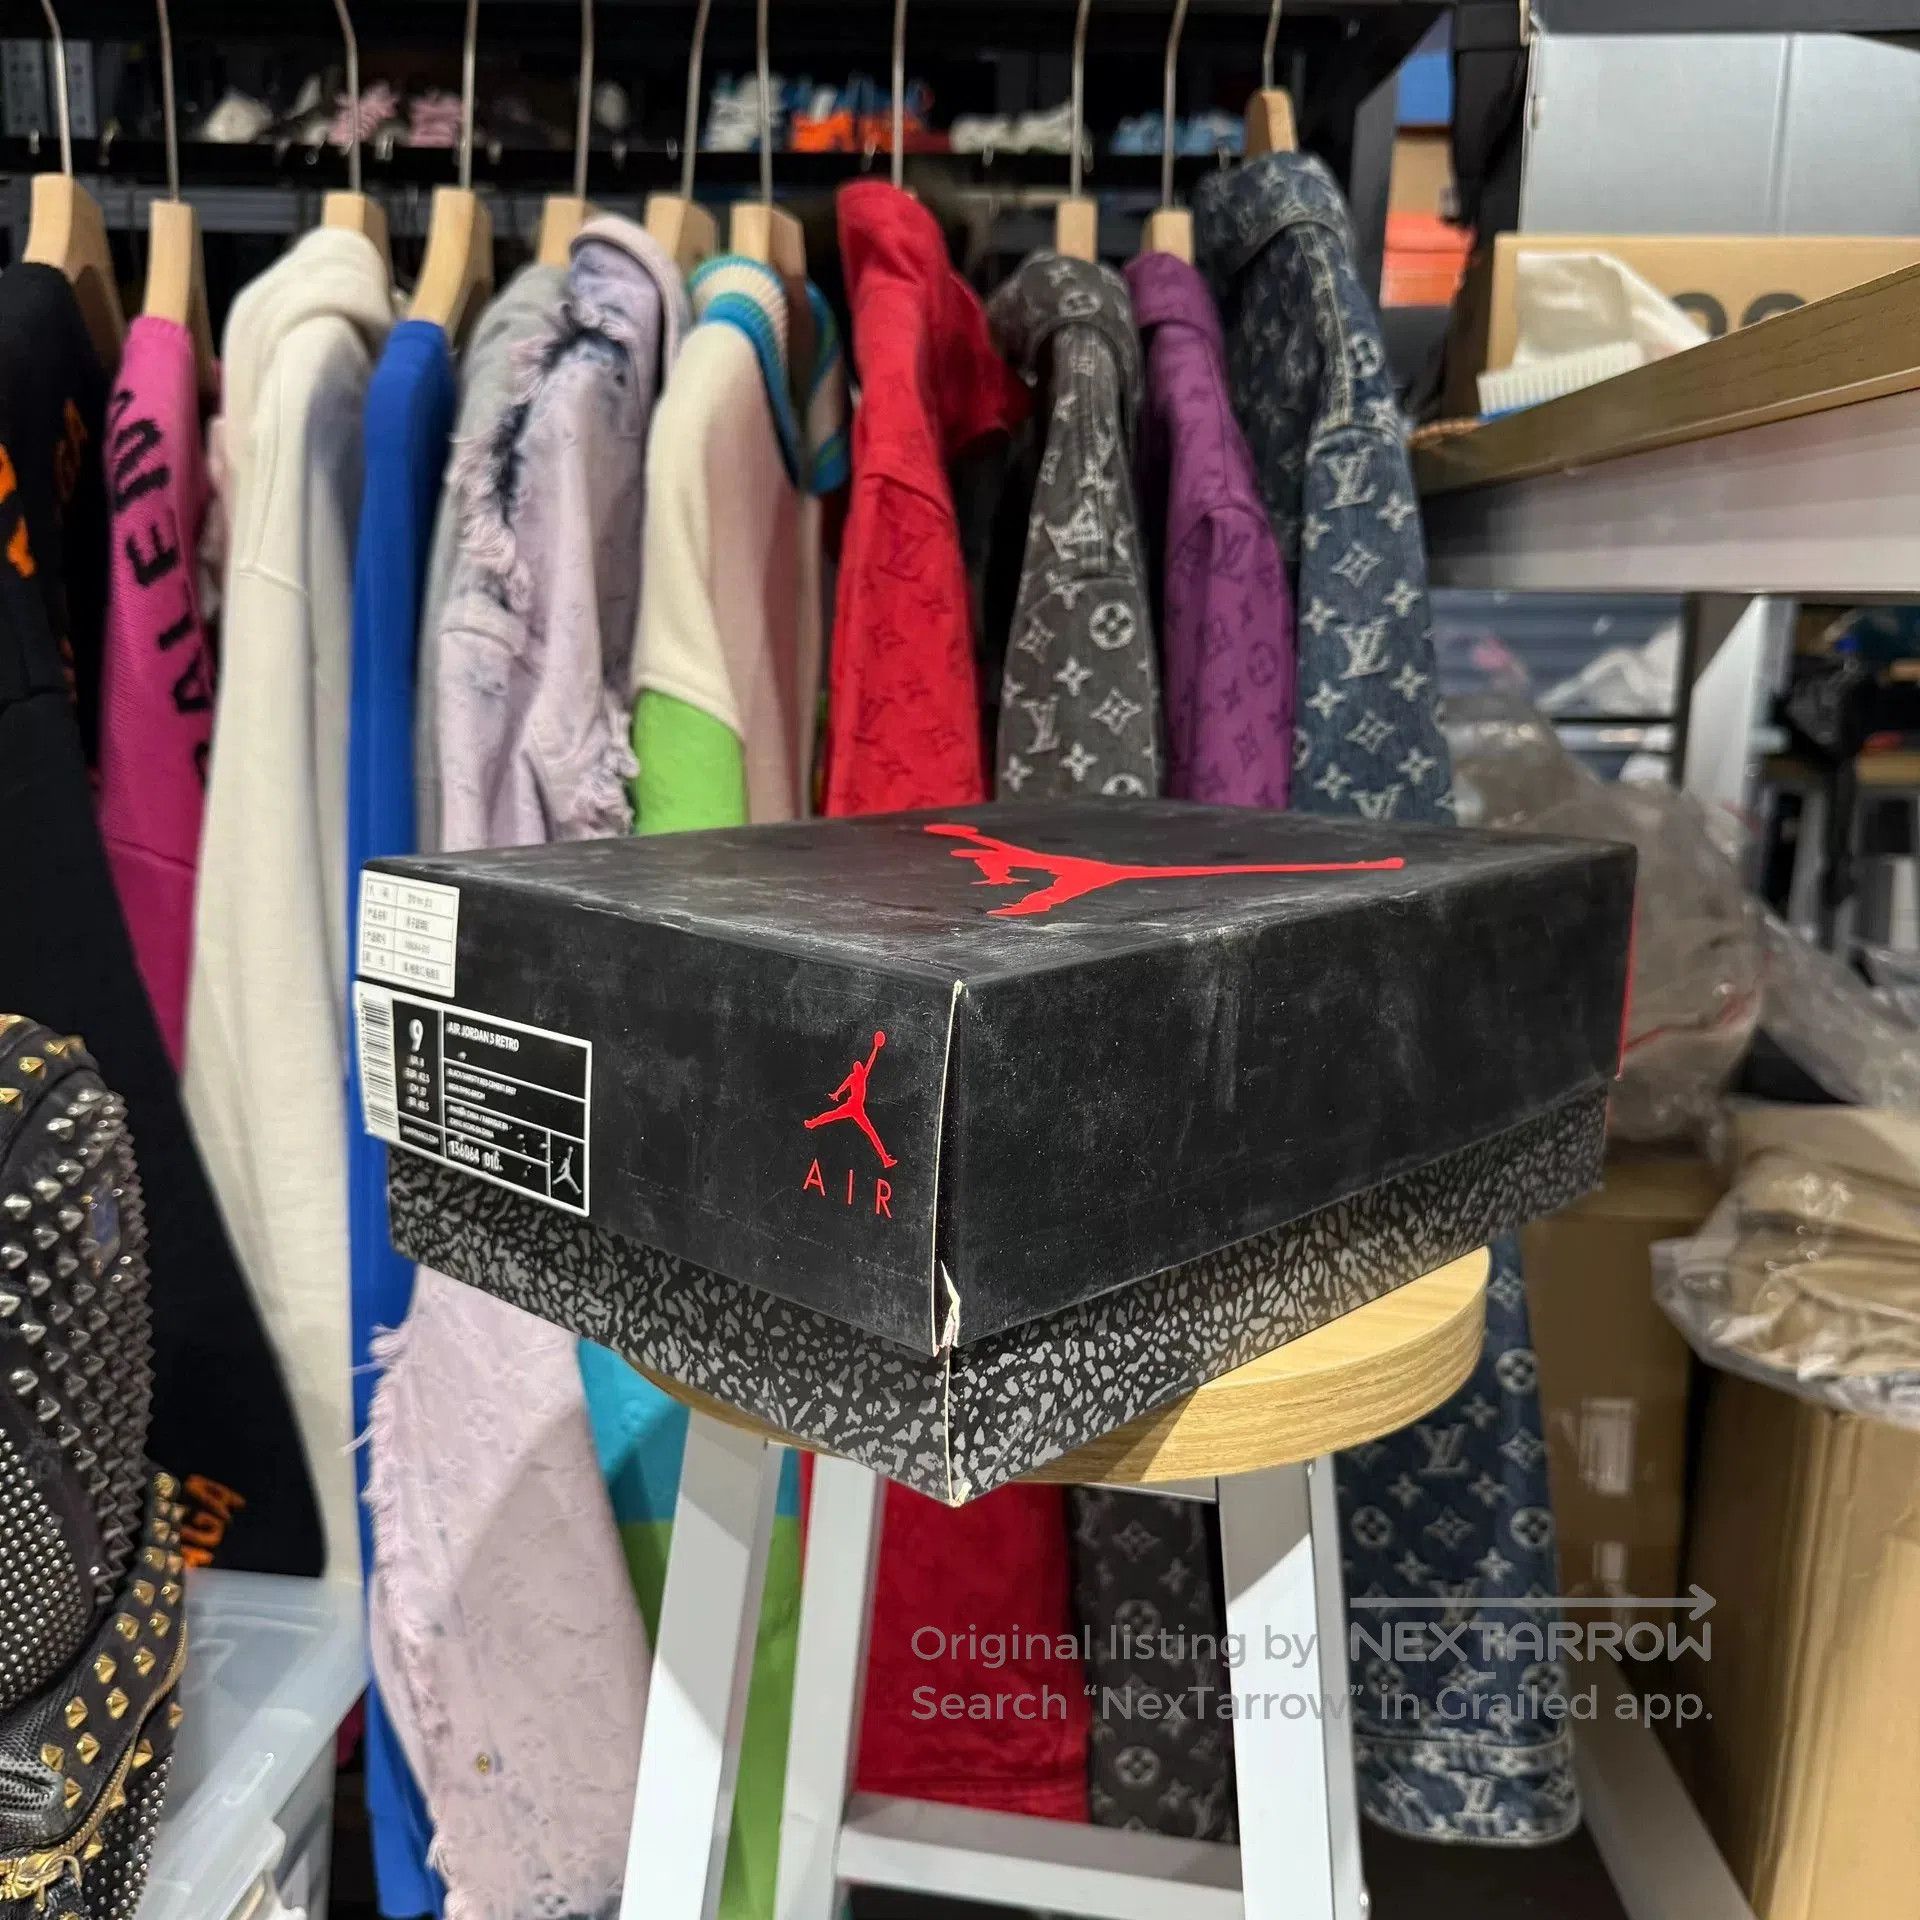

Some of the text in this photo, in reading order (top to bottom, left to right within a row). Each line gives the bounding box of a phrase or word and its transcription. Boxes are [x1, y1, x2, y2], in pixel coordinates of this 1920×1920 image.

[408, 1018, 424, 1052] 9
[461, 1026, 489, 1043] JORDAN
[495, 1034, 520, 1053] RETRO
[803, 1157, 893, 1219] AIR
